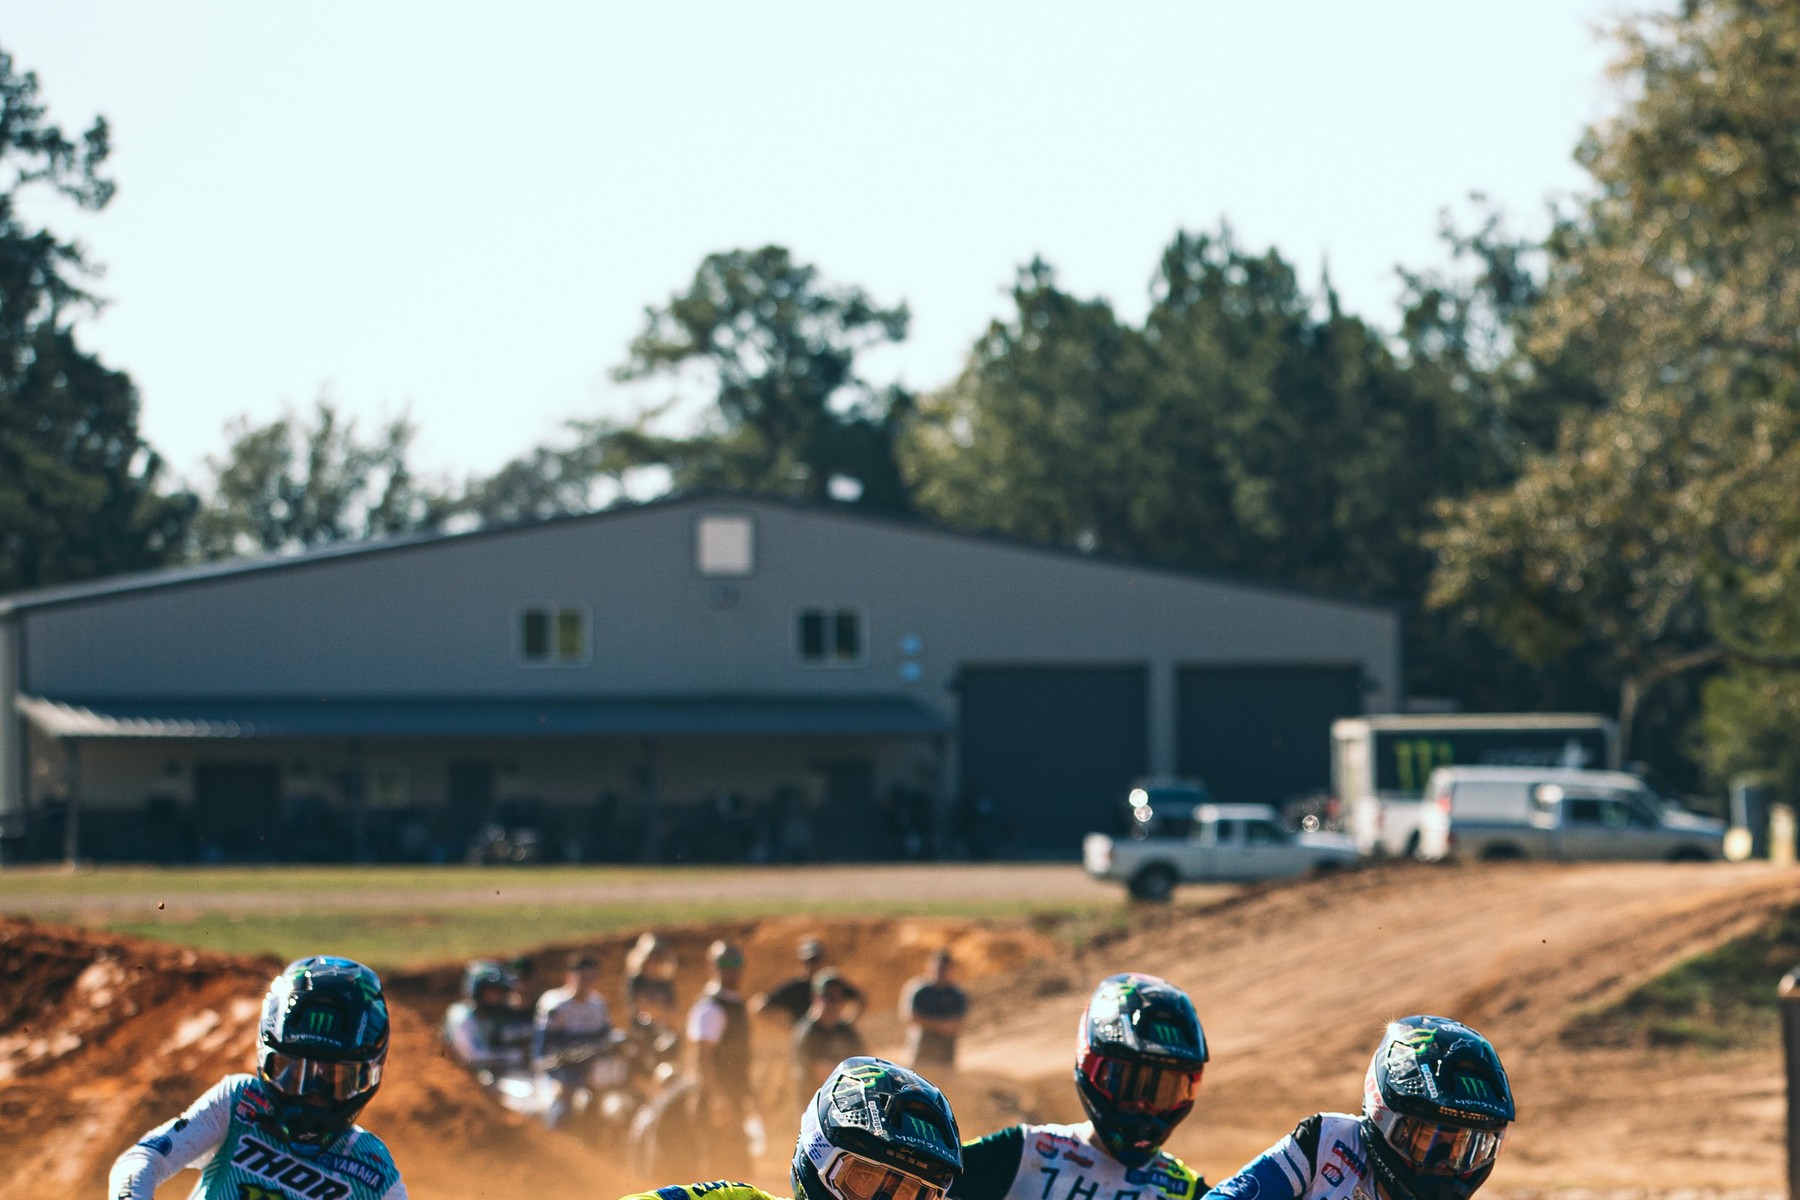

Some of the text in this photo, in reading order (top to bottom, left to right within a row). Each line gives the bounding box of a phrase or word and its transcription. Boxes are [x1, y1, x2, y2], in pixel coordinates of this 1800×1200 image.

[1455, 1099, 1508, 1115] MONSTER
[895, 1134, 955, 1160] MONSTER
[332, 1158, 381, 1188] YAMAHA
